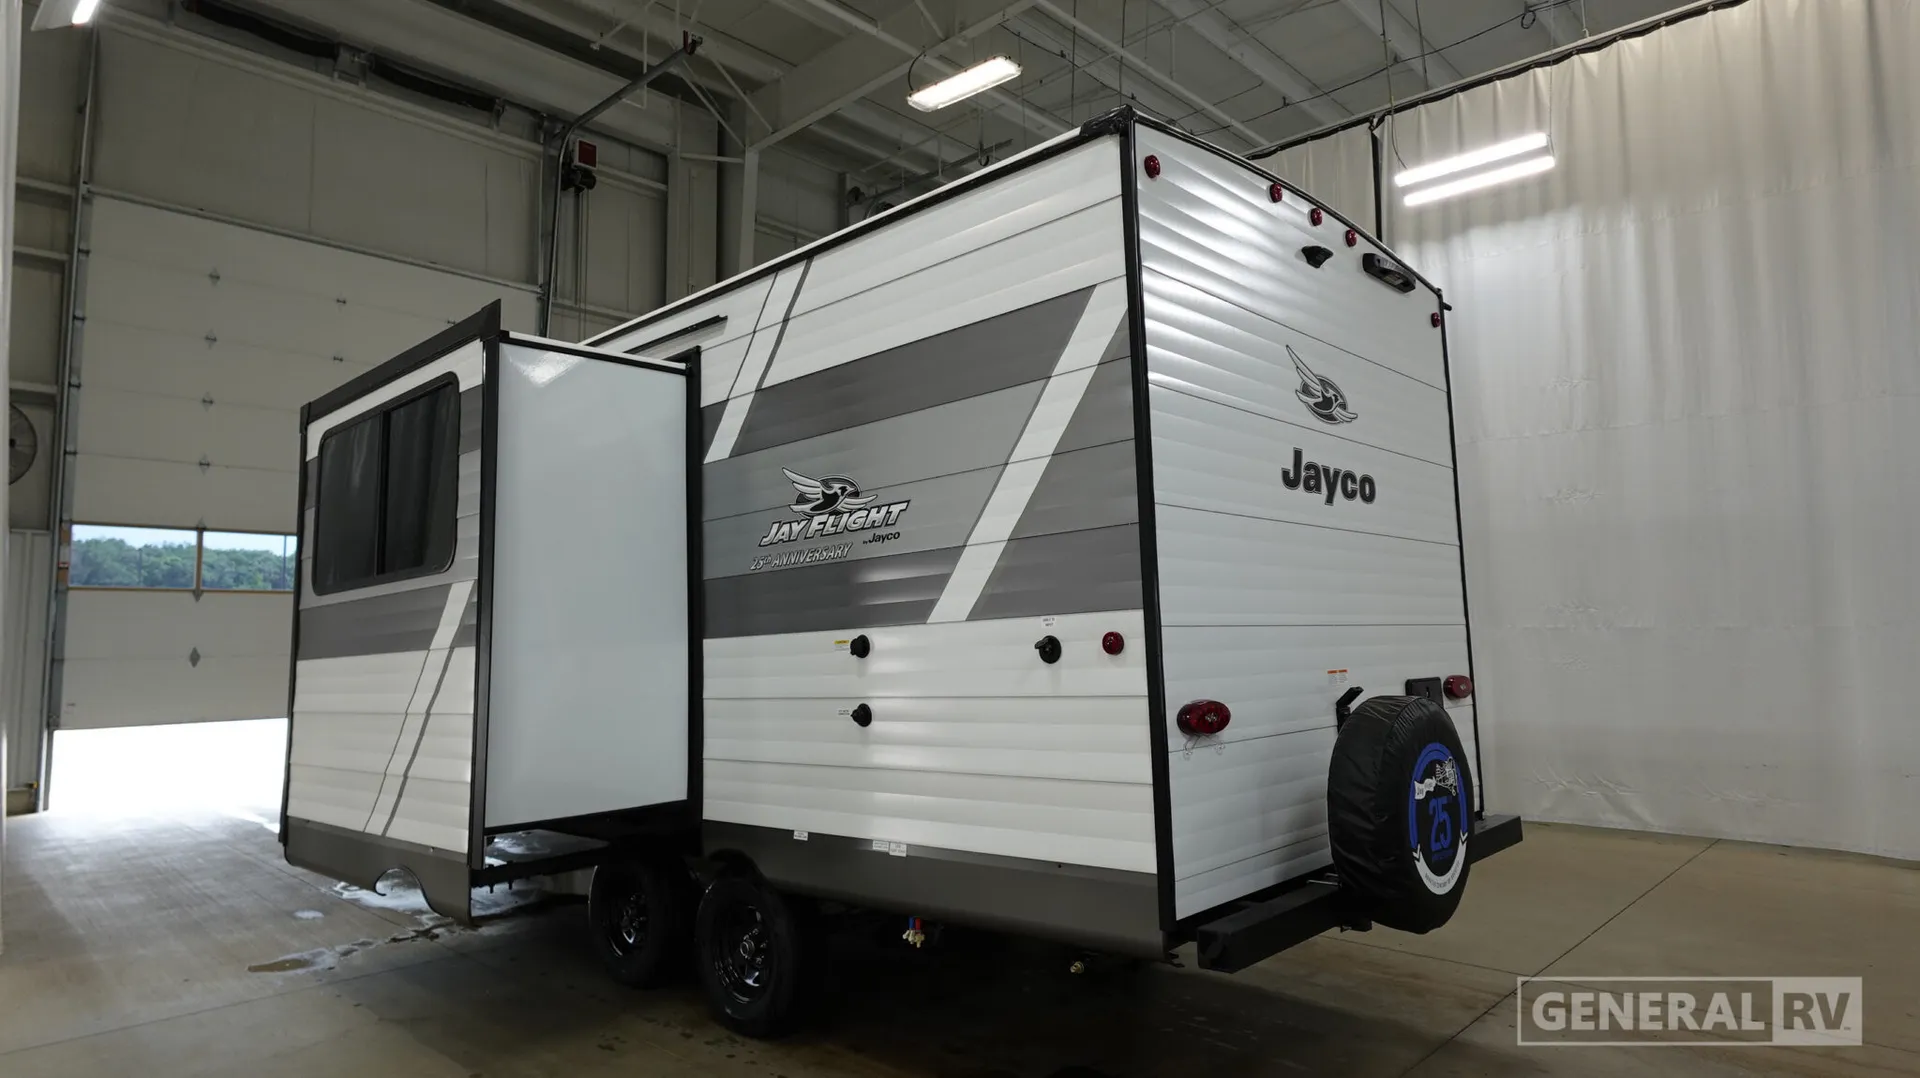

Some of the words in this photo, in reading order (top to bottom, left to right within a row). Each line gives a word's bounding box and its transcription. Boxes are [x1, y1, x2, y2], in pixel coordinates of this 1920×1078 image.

[1281, 447, 1376, 506] Jayco
[758, 520, 808, 547] JAY
[804, 500, 911, 540] FLIGHT
[868, 532, 900, 544] Jayco
[771, 541, 853, 568] ANNIVERSARY
[1428, 796, 1452, 852] 25
